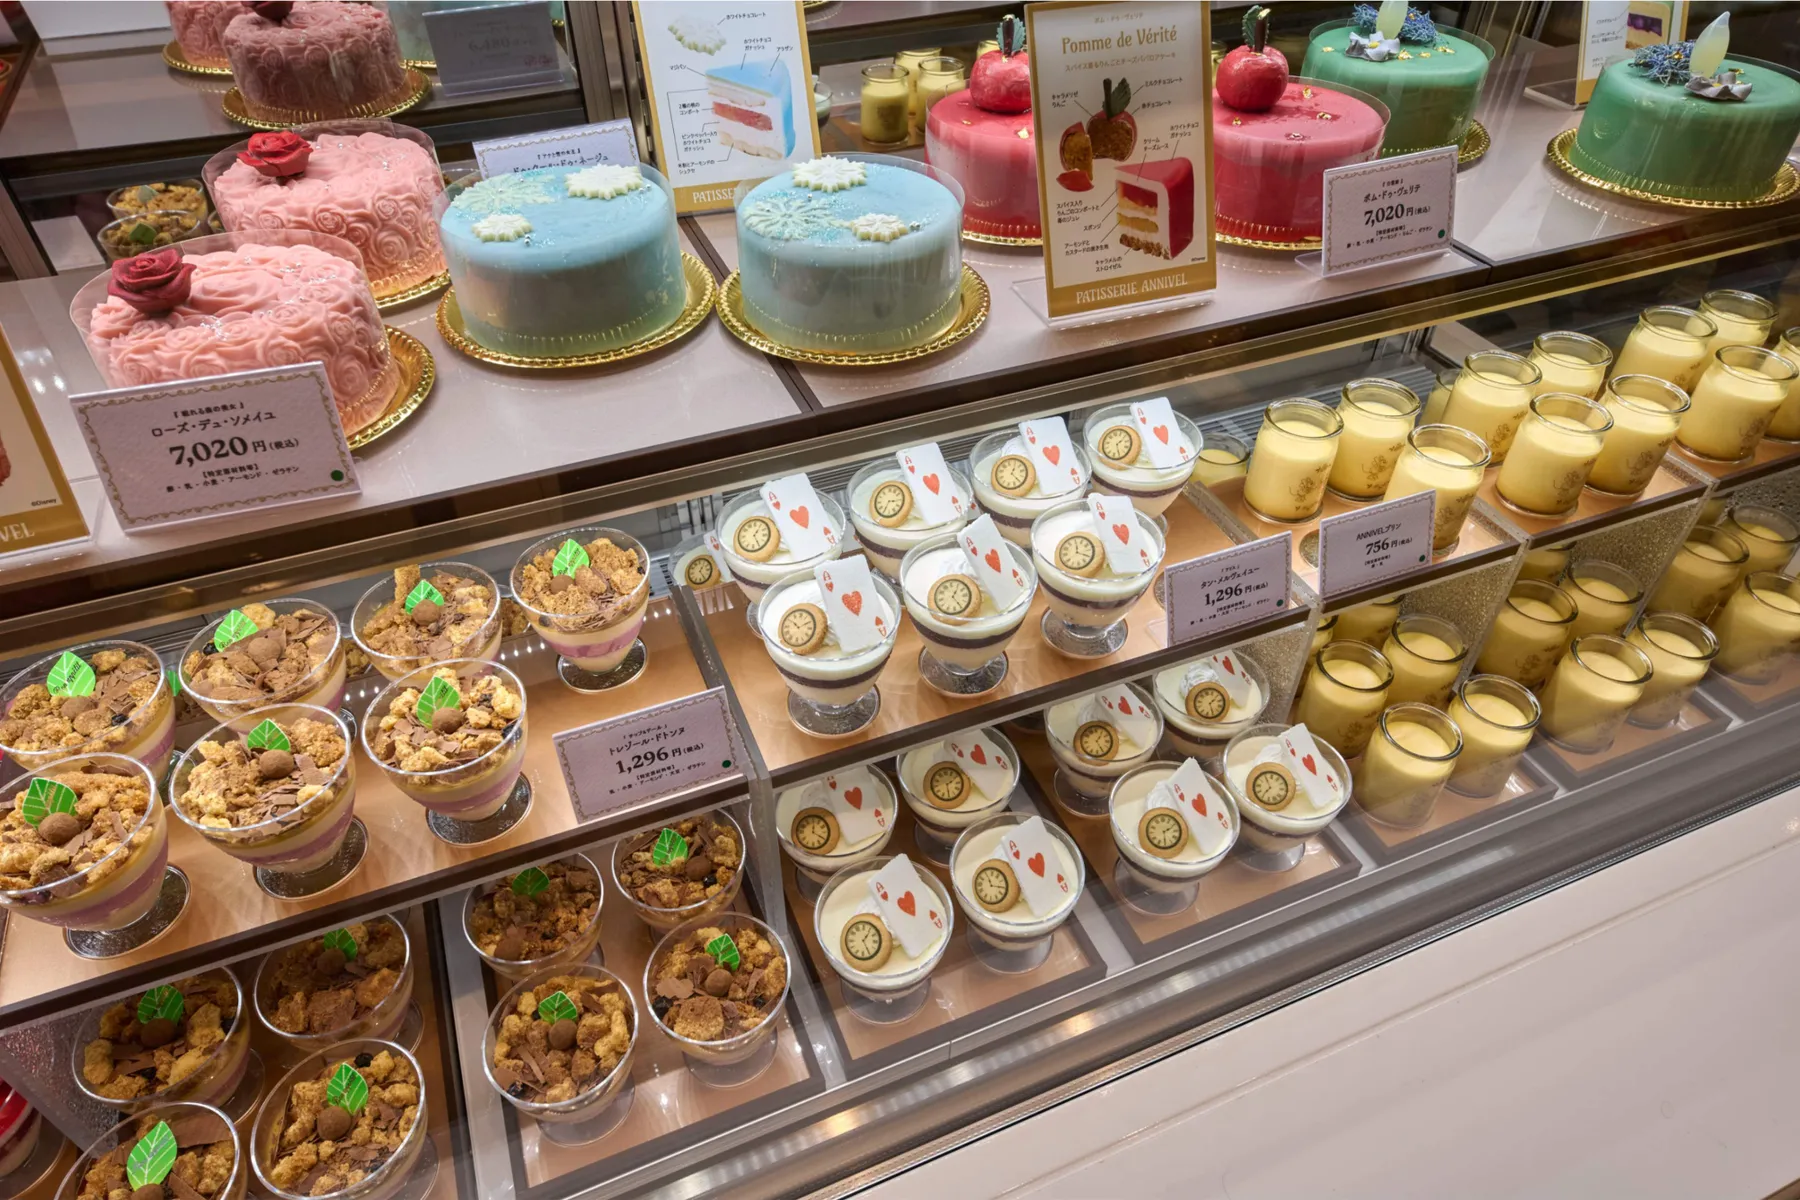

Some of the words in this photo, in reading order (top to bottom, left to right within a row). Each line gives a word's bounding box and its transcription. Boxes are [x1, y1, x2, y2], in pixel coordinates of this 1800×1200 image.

[1062, 36, 1112, 54] Pomme
[1116, 31, 1132, 48] de
[1136, 25, 1178, 45] Vérité
[692, 187, 736, 204] PATISSE
[1076, 282, 1138, 304] PATISSERIE
[1142, 272, 1188, 292] ANNIVEL
[152, 410, 276, 438] ローズ・デュ・ソメイユ
[1356, 523, 1402, 541] ANNIVELプリン
[608, 726, 686, 756] トレゾール・ドトンヌ
